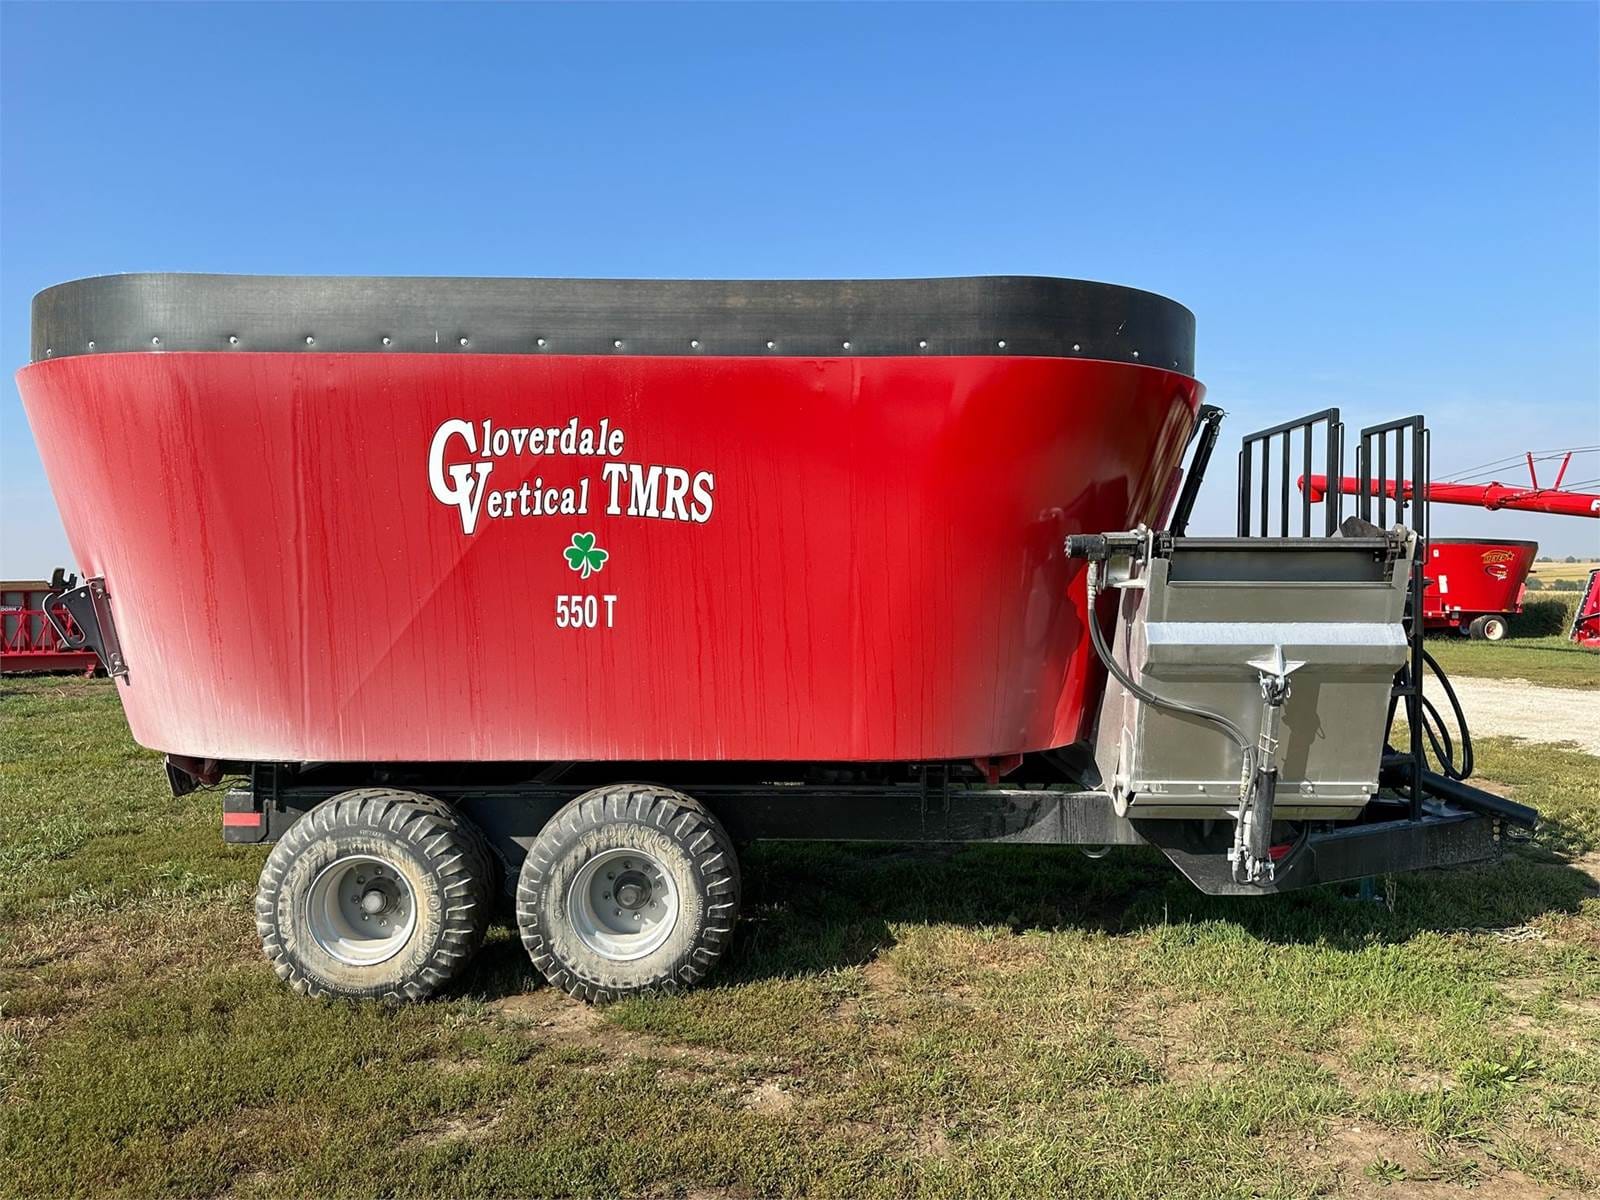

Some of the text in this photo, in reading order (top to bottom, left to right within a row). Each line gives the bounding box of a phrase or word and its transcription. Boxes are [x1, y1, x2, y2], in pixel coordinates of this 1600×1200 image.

[448, 462, 715, 535] Vertical TMRS
[555, 594, 618, 629] 550 T
